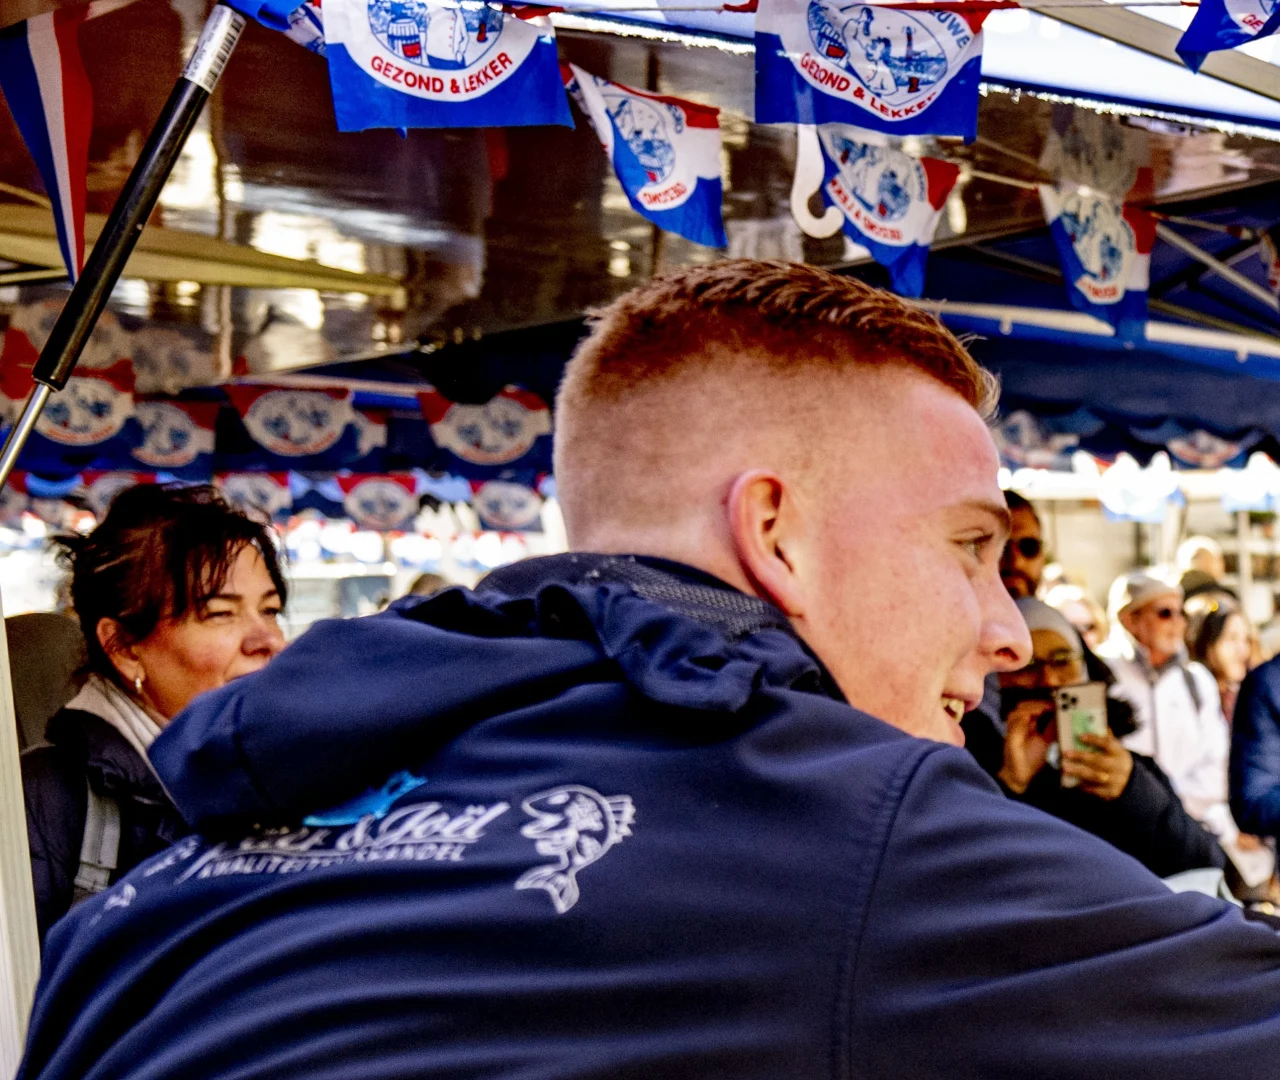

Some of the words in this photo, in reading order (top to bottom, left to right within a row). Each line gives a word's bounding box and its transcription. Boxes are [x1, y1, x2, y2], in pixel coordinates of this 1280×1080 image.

[371, 55, 444, 93] GEZOND
[450, 78, 460, 94] &
[463, 52, 514, 93] LEKKER
[800, 52, 850, 92] GEZOND
[853, 87, 865, 100] &
[377, 801, 511, 847] Joël
